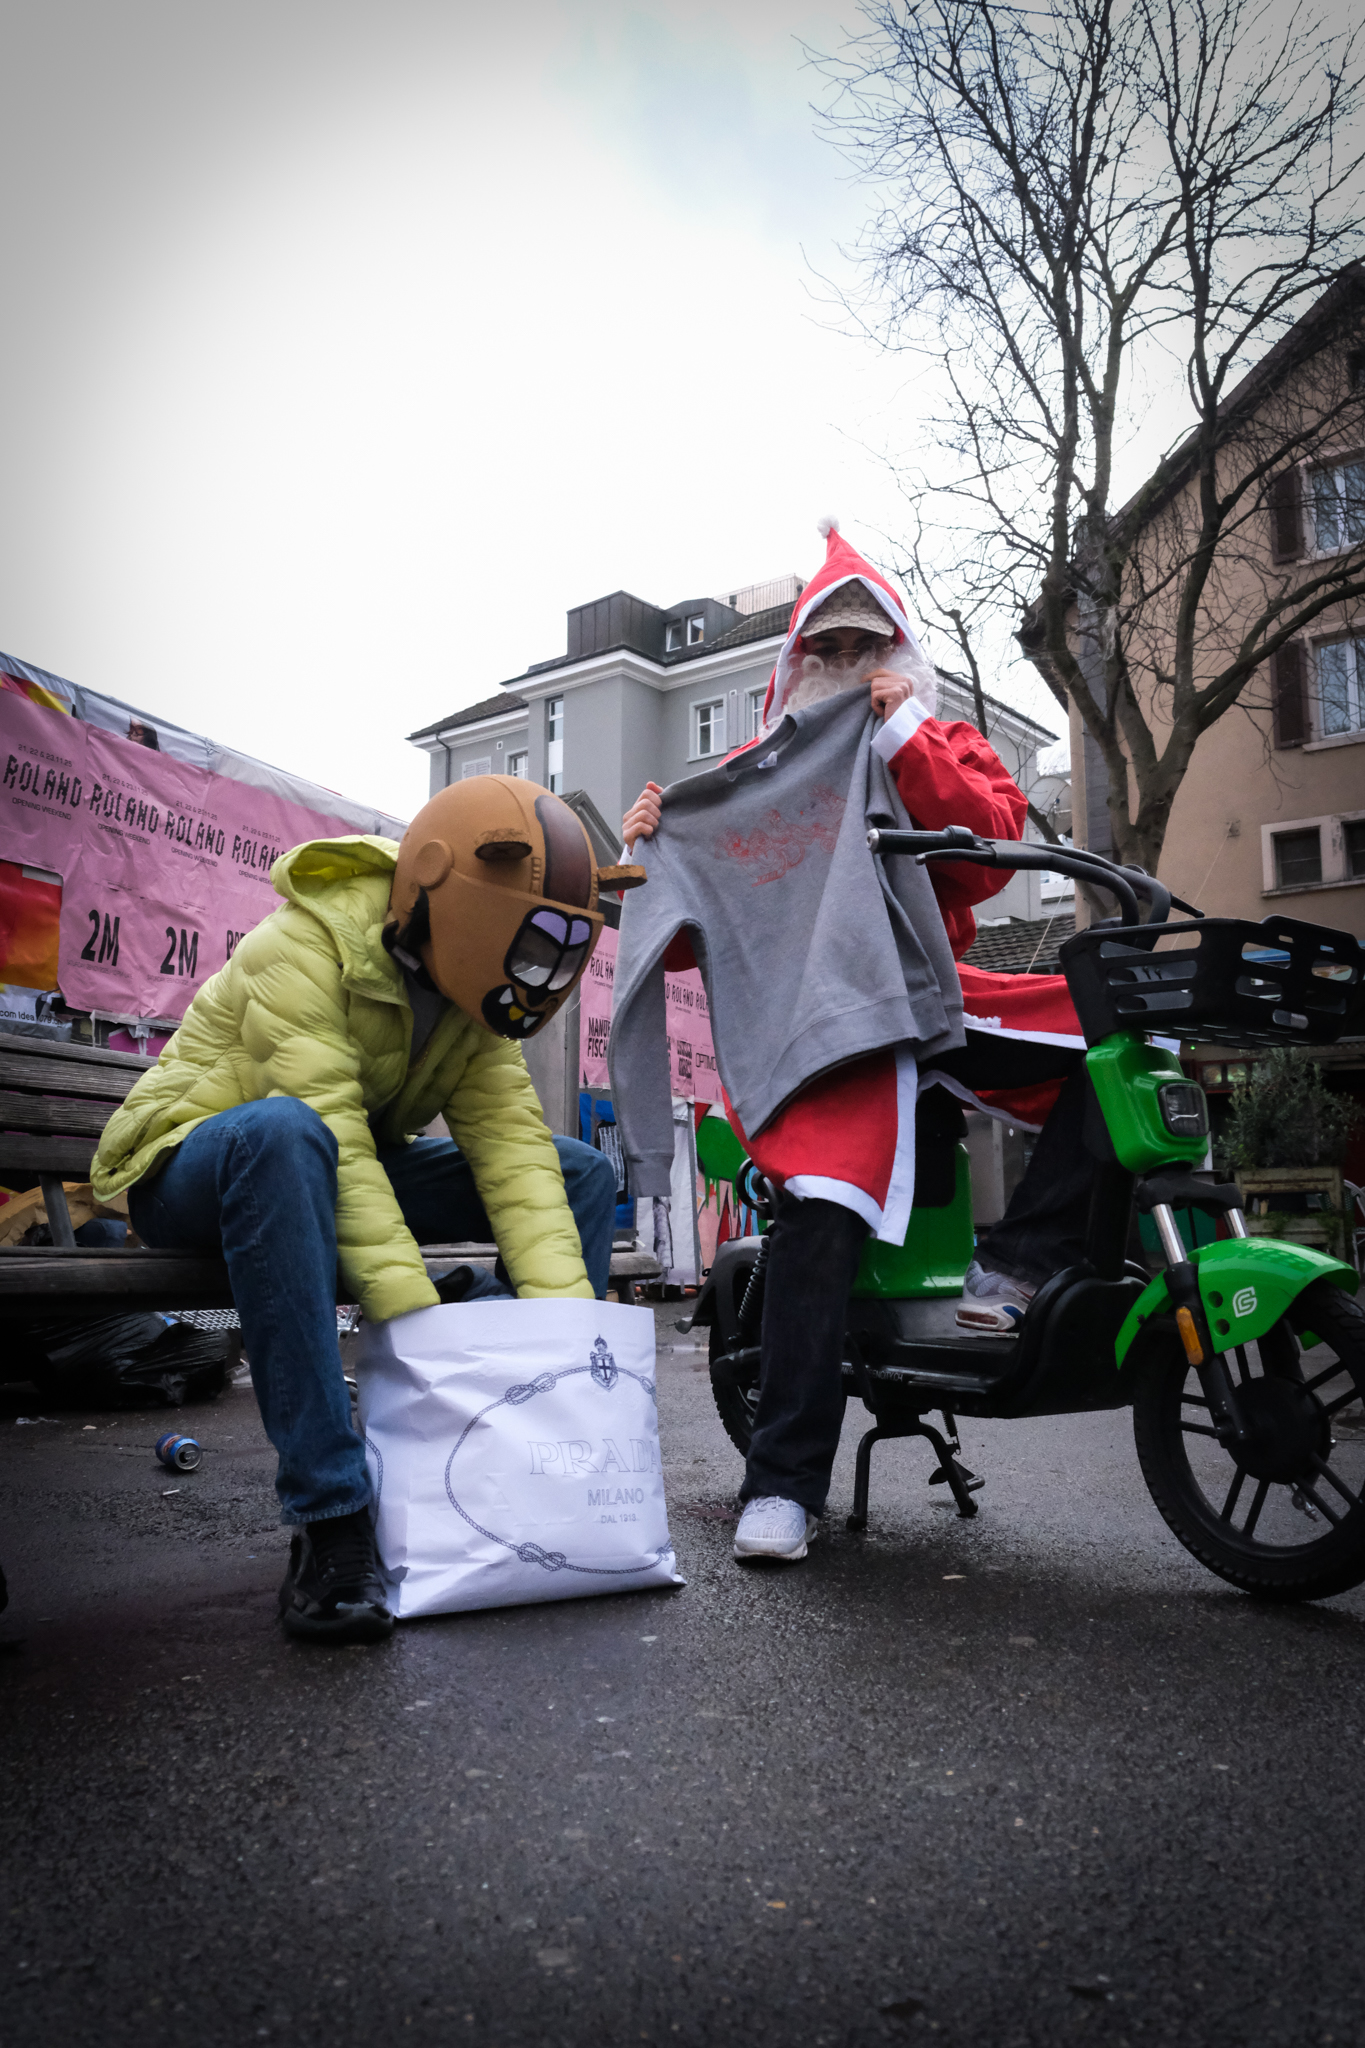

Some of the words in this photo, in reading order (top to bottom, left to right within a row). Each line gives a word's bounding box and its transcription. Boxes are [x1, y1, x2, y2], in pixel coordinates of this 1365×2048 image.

[3, 754, 82, 808] ROLAND
[12, 797, 41, 810] OPENING
[41, 805, 72, 820] WEEKEND
[89, 783, 159, 834] ROLAND
[97, 823, 123, 836] OPENING
[124, 831, 150, 845] WEEKEND
[164, 810, 225, 856] ROLAND
[170, 846, 193, 859] OPENING
[231, 834, 286, 872] ROLAN
[238, 869, 258, 880] OPENING
[80, 909, 121, 967] 2M
[160, 926, 199, 979] 2M
[587, 1487, 645, 1507] MILANO
[600, 1514, 617, 1525] DAL
[619, 1513, 638, 1523] 1913
